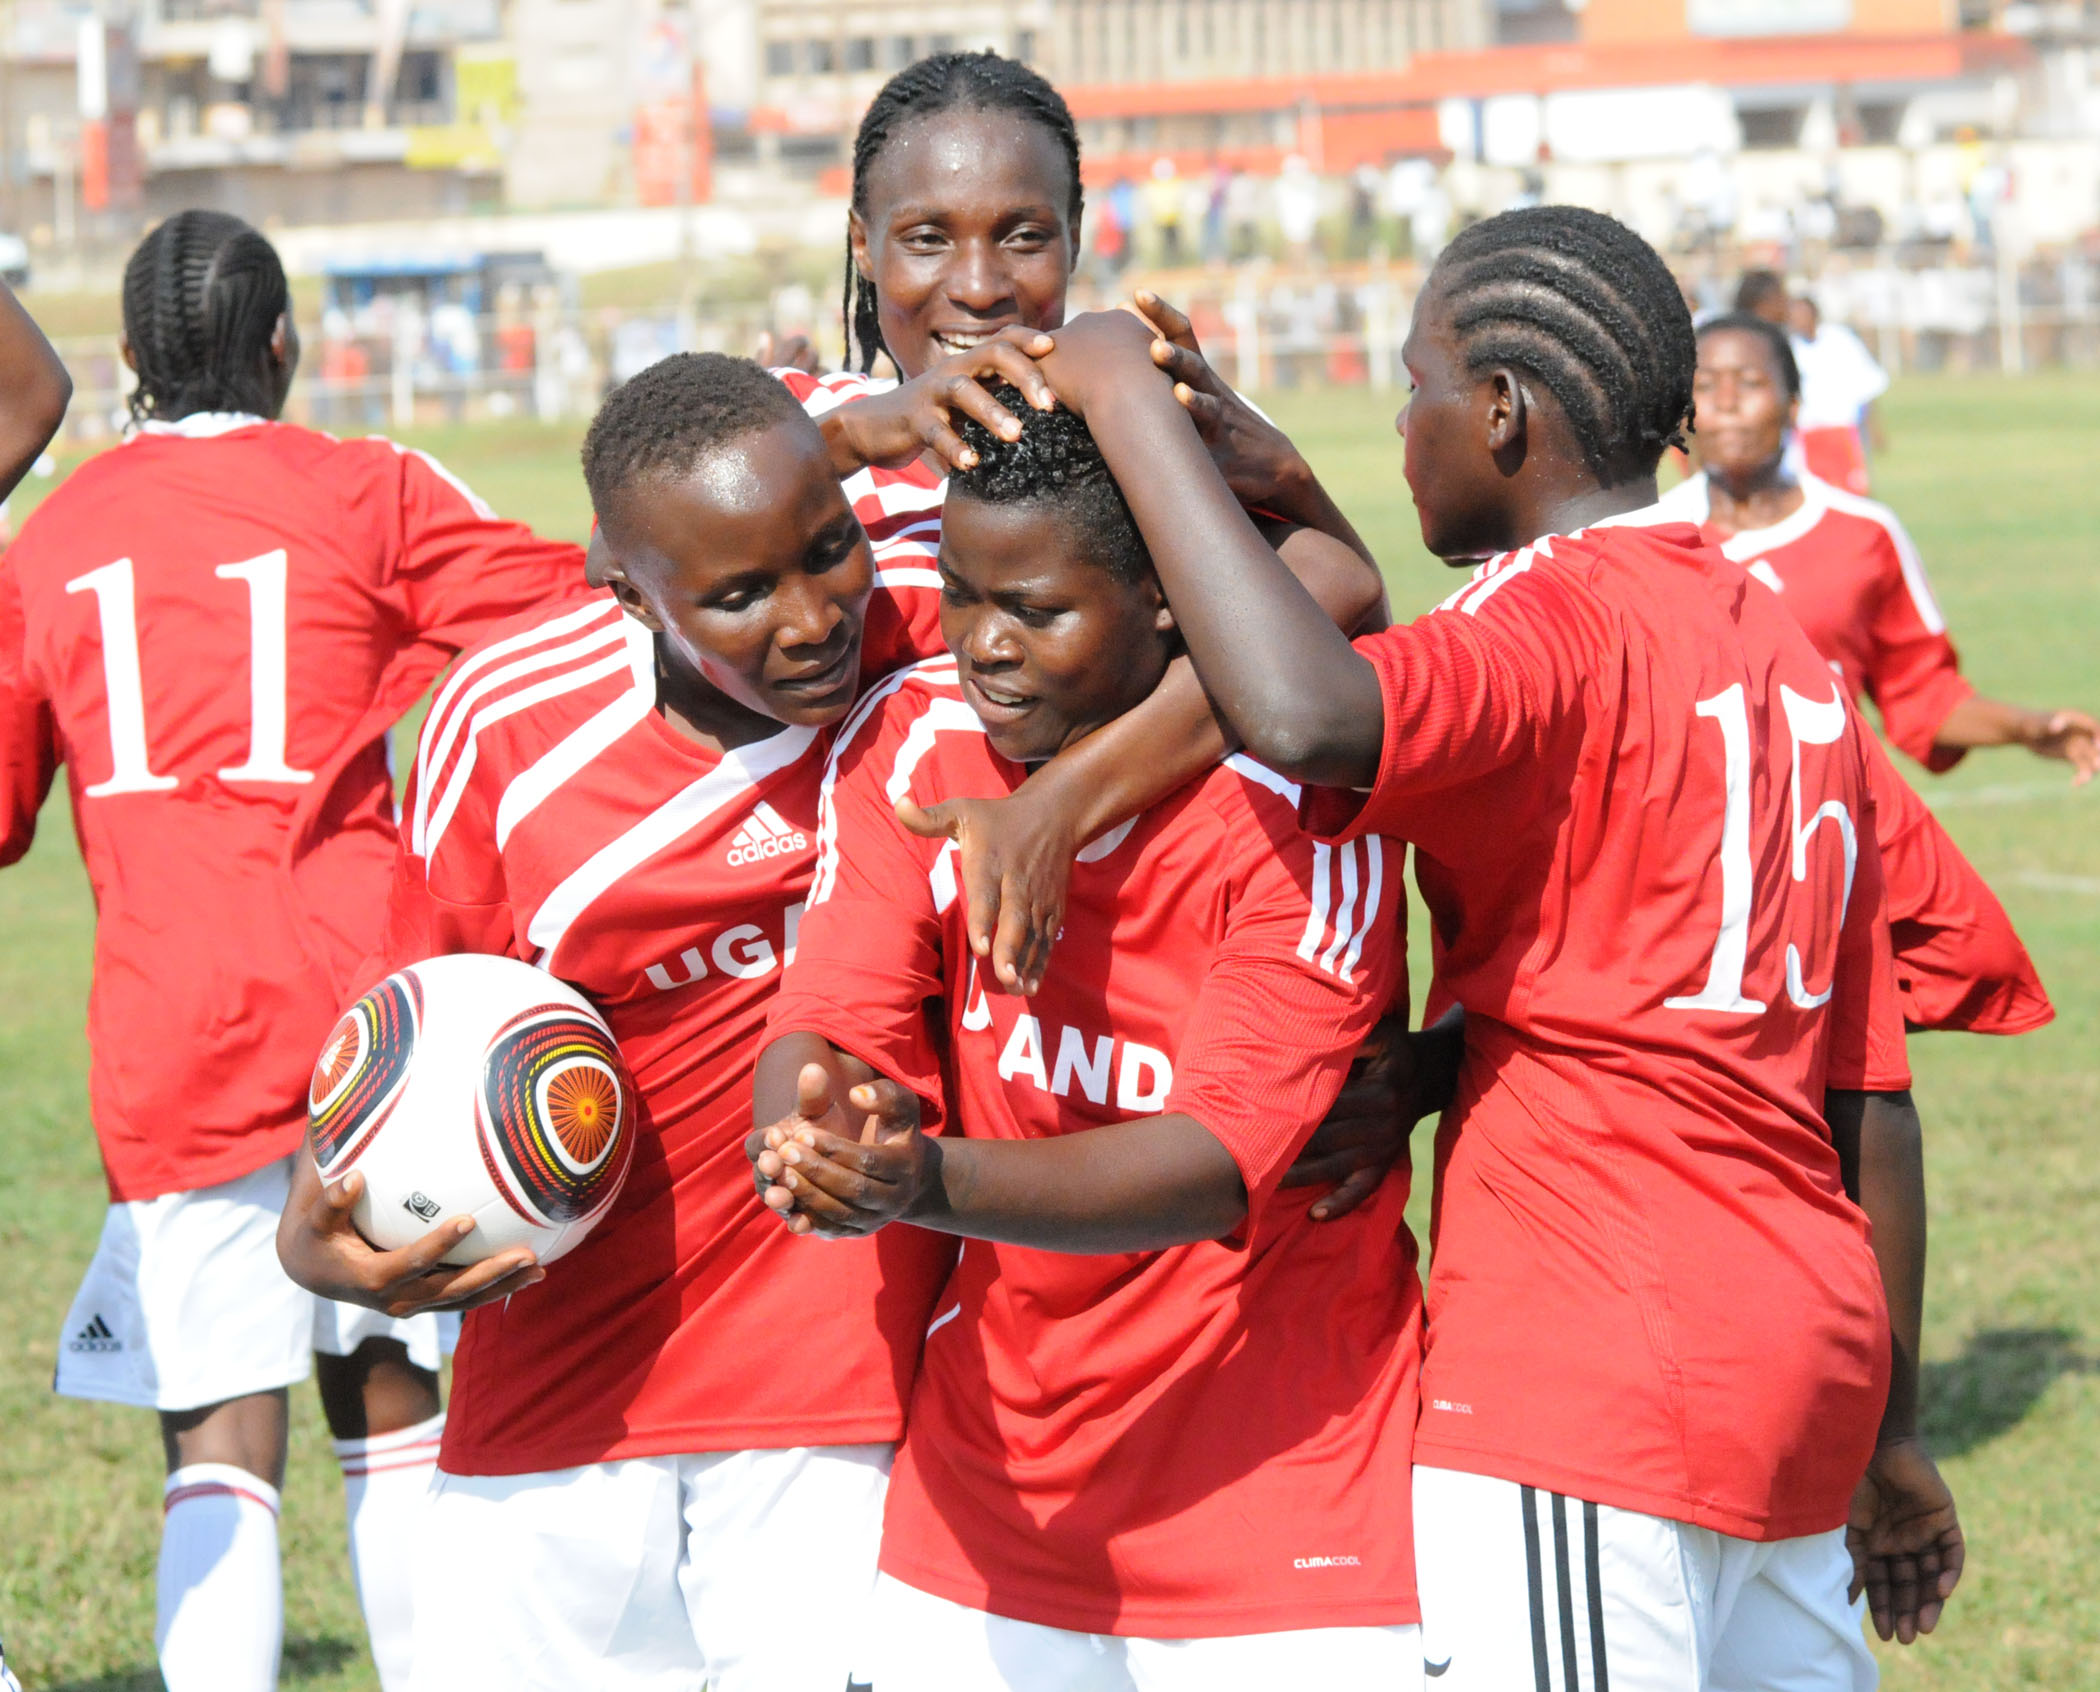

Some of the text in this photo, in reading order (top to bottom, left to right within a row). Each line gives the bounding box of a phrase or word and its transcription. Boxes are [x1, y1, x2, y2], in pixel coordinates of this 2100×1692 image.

[65, 547, 316, 798] 11
[727, 832, 808, 867] adidas
[1663, 682, 1859, 1015] 15
[1293, 1556, 1362, 1569] CLIMACOOL
